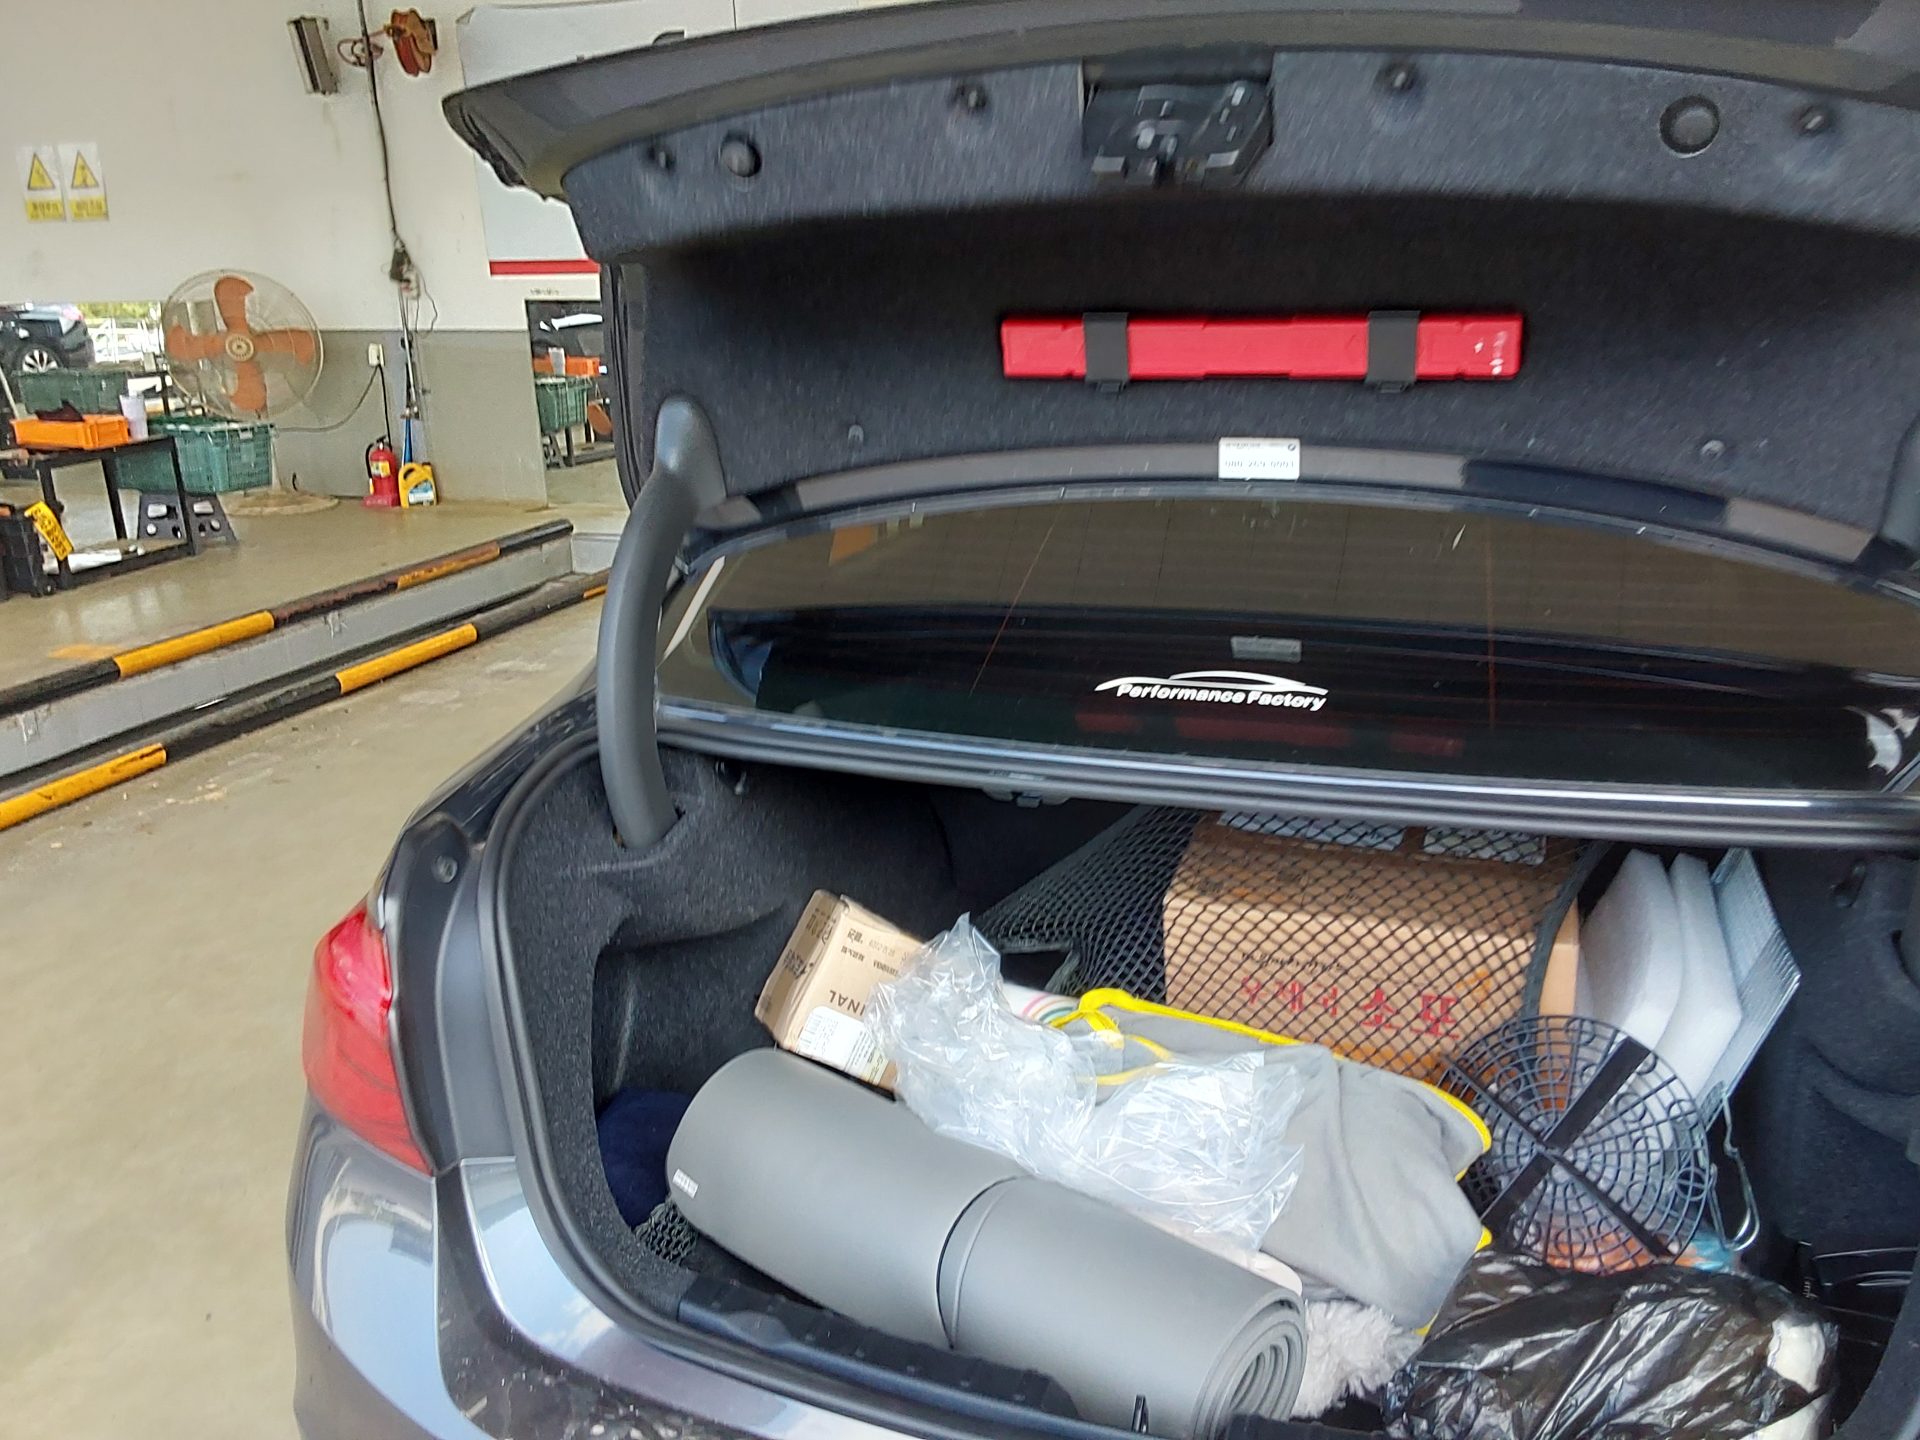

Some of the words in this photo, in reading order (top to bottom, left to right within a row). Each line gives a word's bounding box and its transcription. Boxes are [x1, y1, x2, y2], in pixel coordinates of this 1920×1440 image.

[1116, 683, 1246, 704] Performance
[1246, 690, 1328, 712] Factory
[828, 989, 867, 1017] INAL
